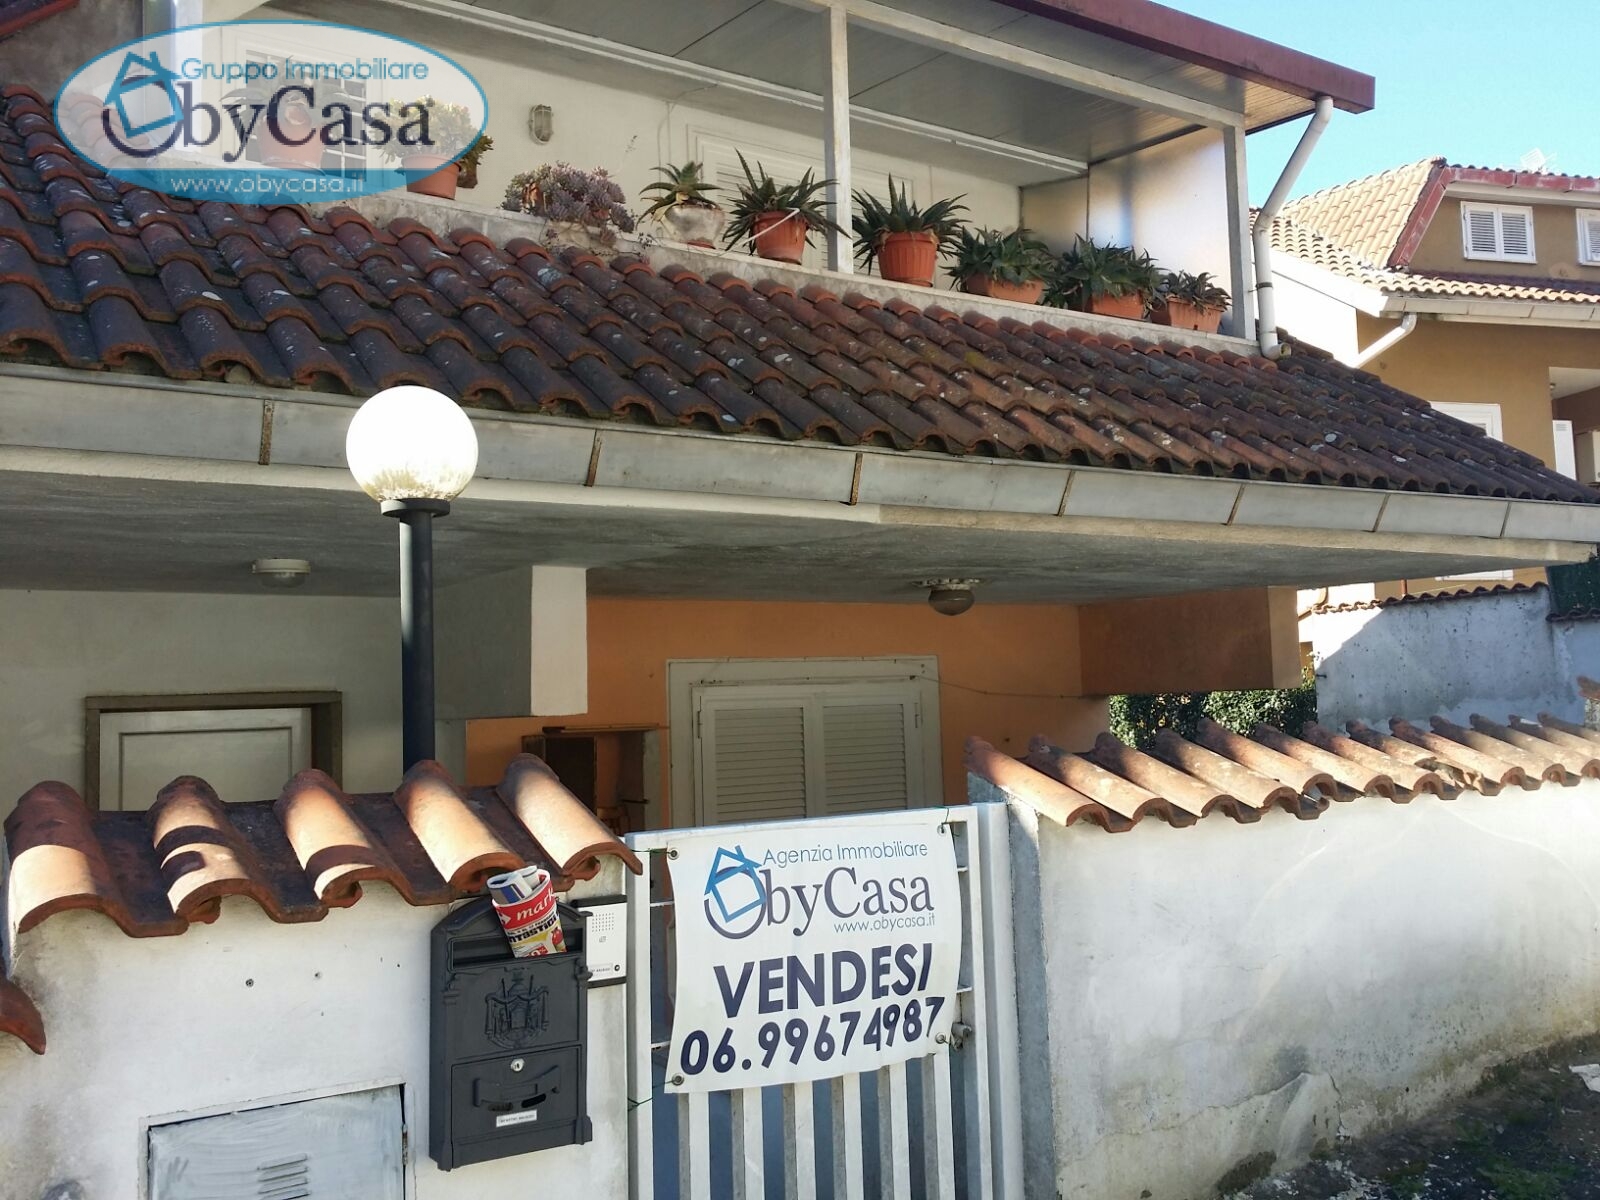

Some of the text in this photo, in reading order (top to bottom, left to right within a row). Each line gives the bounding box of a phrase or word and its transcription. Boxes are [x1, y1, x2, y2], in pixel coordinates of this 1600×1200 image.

[763, 841, 928, 868] Agenzia Immobiliare
[833, 915, 936, 934] www.obycasa.it
[713, 942, 933, 1019] VENDESI
[680, 996, 946, 1076] 06.99674987
